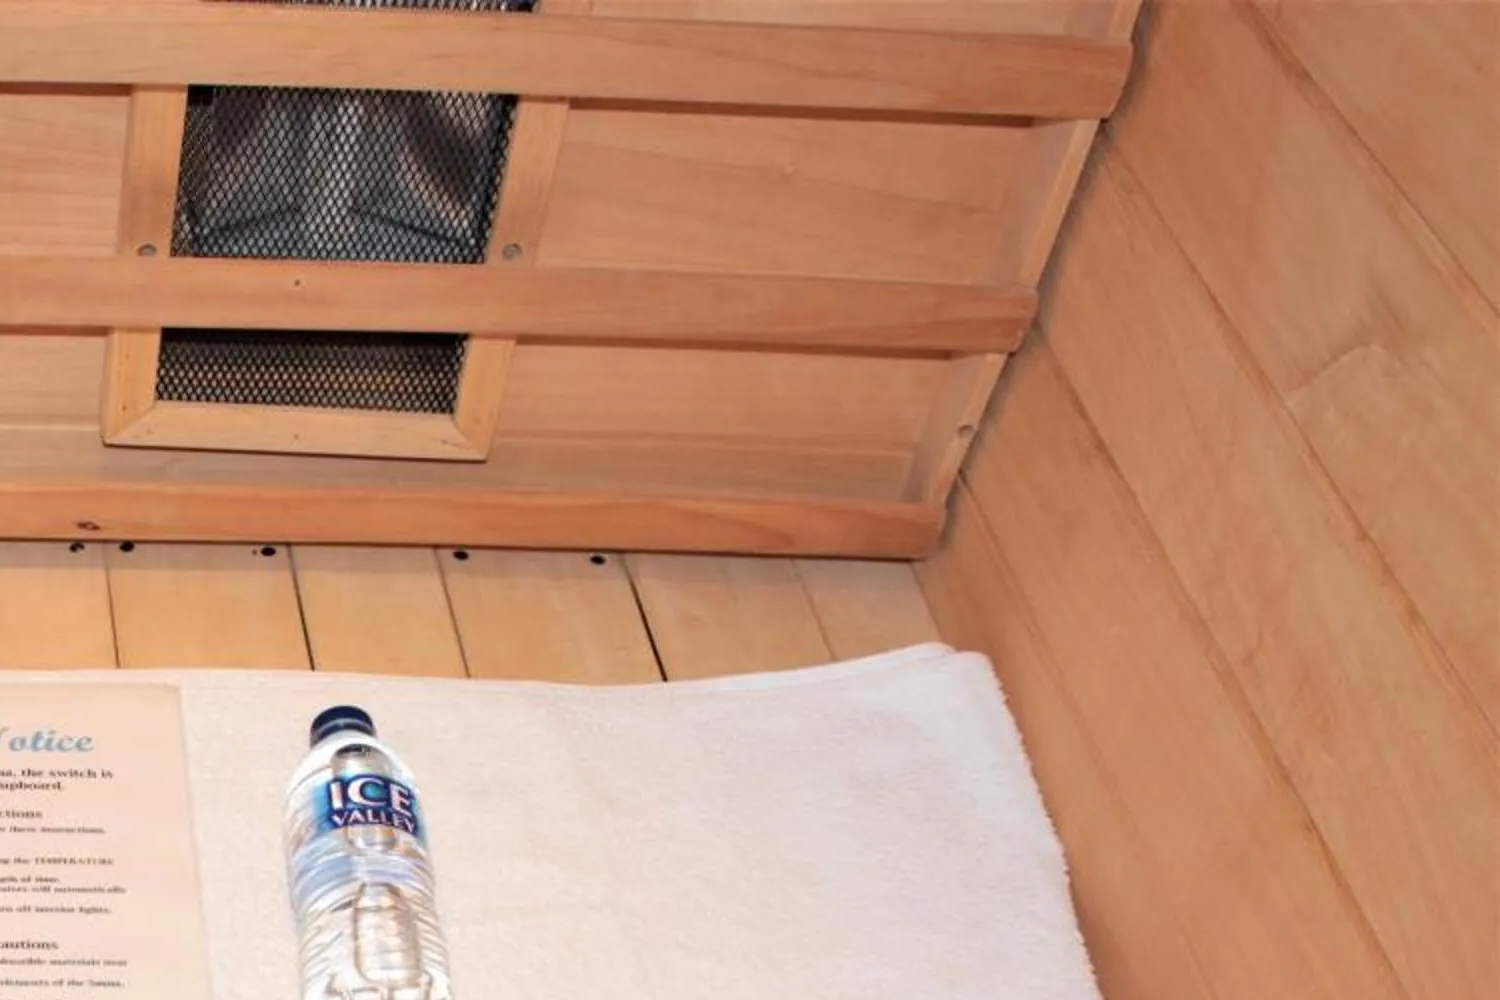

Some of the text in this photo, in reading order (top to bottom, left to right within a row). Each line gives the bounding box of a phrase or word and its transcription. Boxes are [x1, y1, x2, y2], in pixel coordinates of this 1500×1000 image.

[21, 769, 44, 778] the
[49, 769, 97, 779] switch
[101, 770, 113, 779] is
[329, 777, 412, 817] ICE
[331, 808, 416, 833] VALLEY
